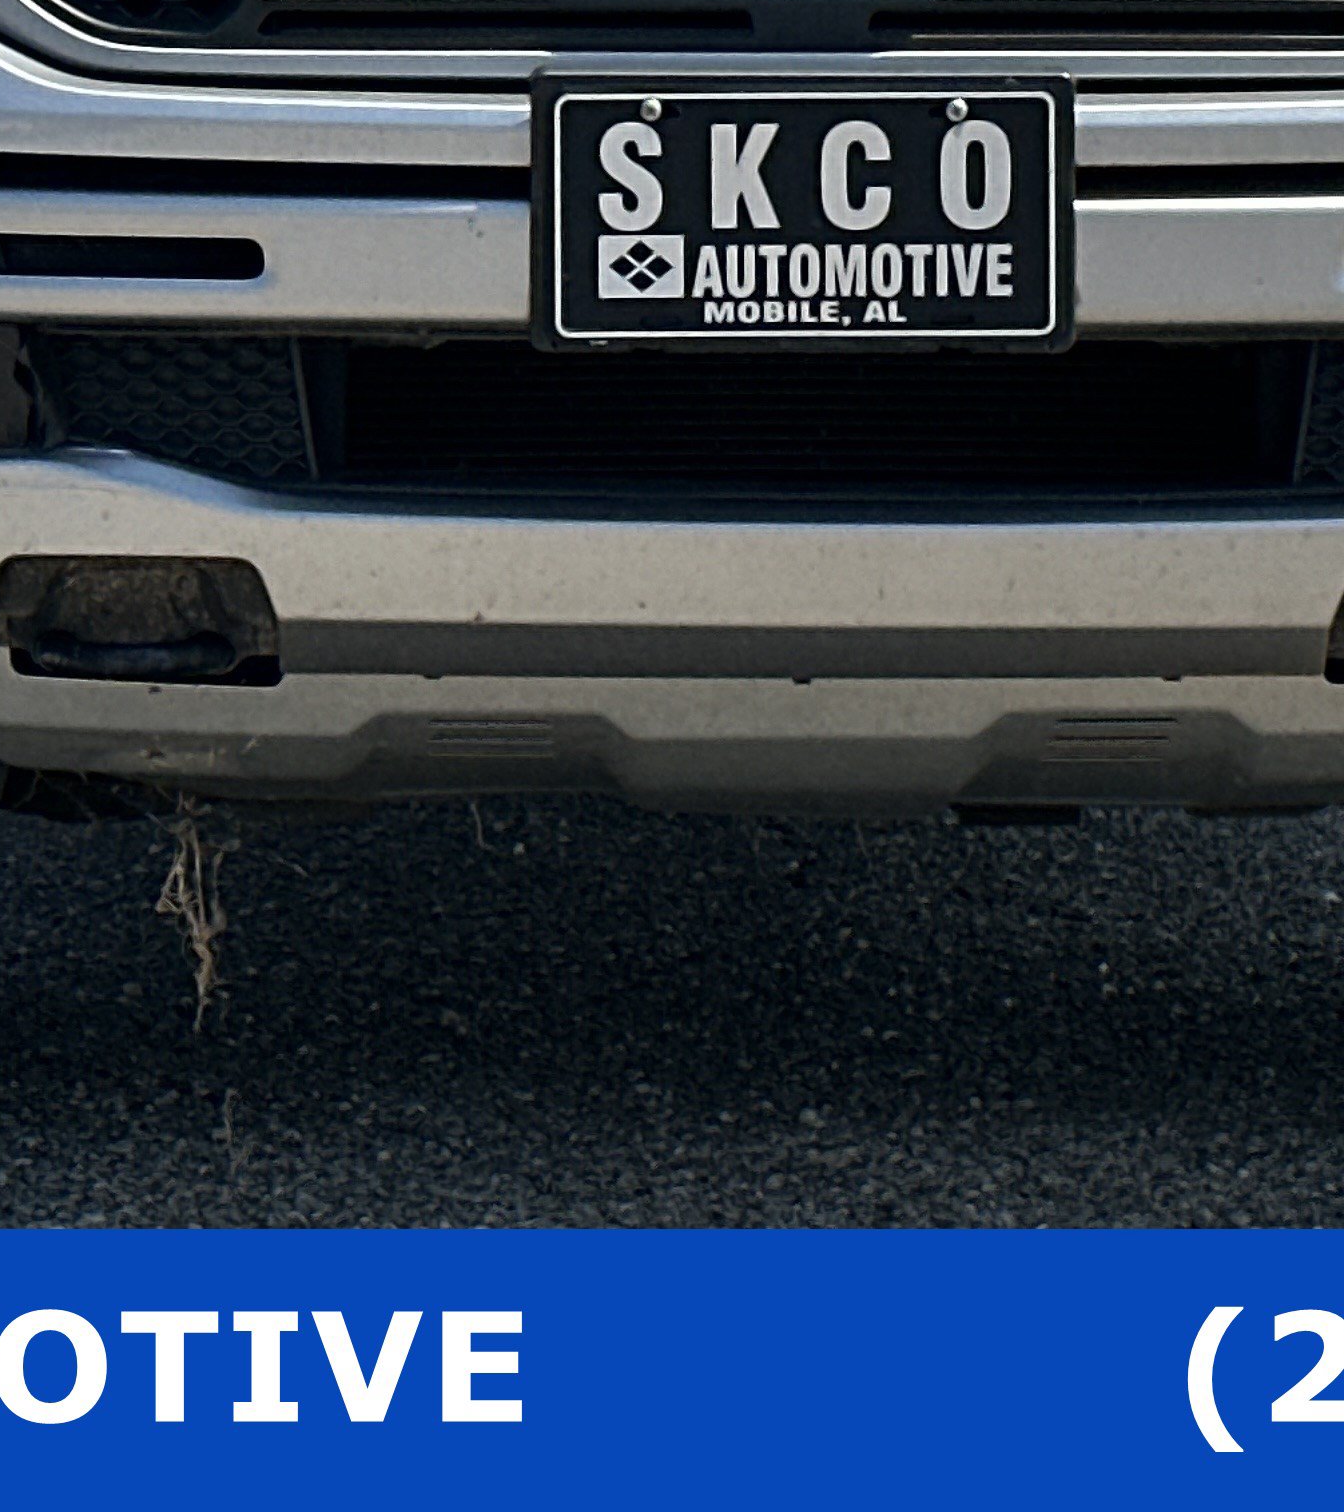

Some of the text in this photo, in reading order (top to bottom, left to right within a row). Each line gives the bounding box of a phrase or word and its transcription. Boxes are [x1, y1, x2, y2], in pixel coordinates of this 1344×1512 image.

[598, 120, 1011, 232] SKCO
[691, 243, 1013, 298] AUTOMOTIVE
[703, 300, 907, 326] MOBILE, AL
